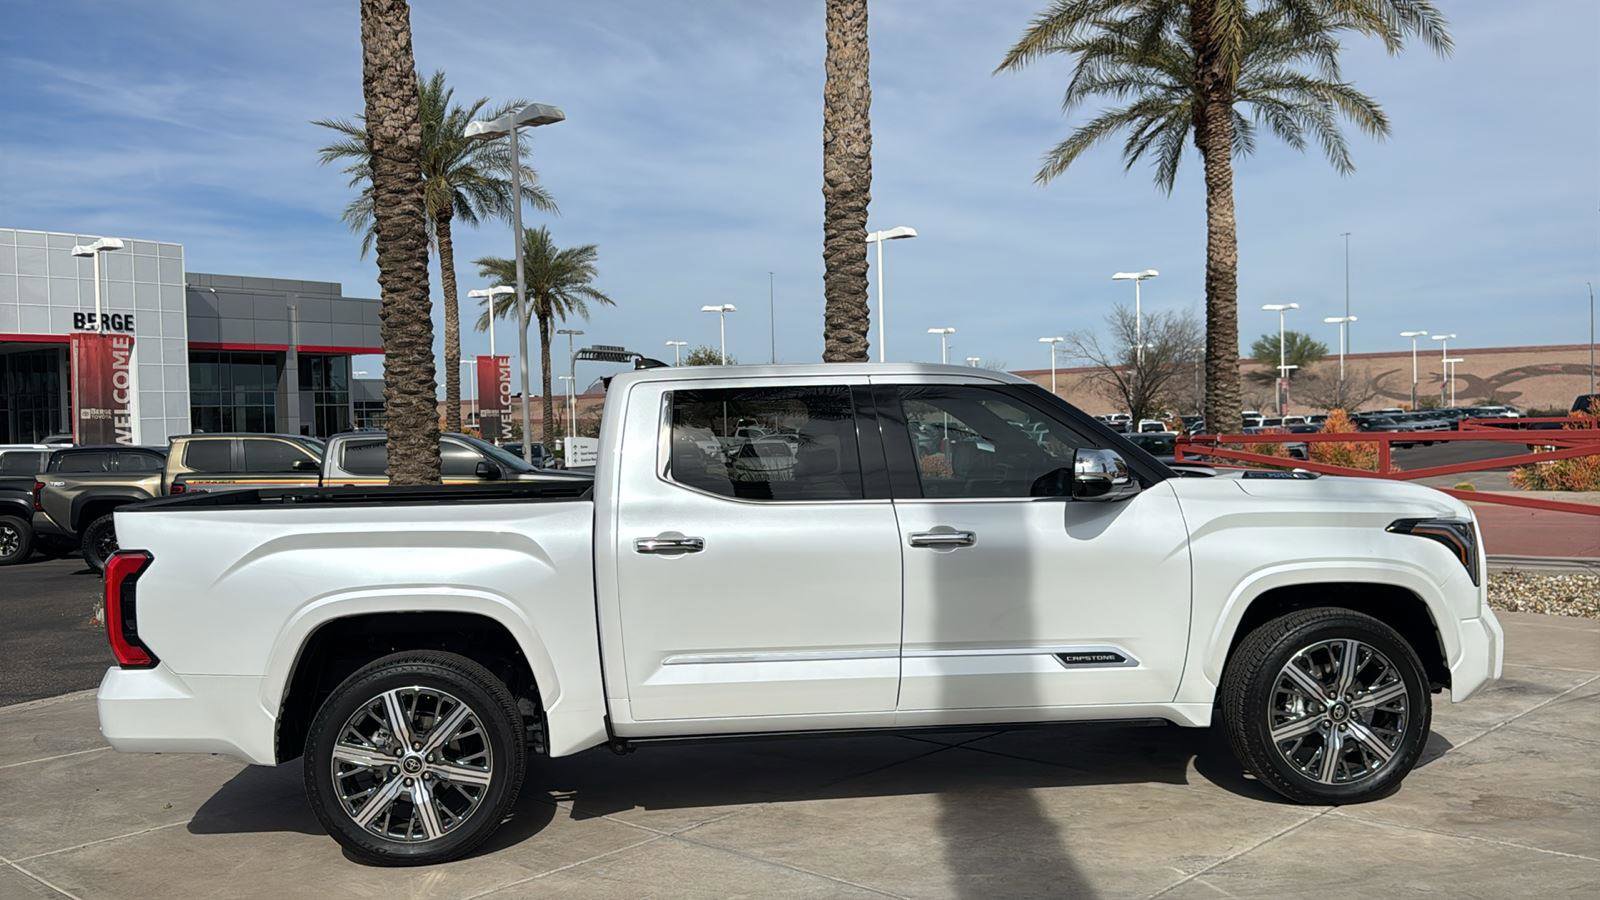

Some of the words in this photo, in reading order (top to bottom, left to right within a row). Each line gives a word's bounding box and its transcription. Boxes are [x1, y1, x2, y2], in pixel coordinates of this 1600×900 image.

[73, 312, 135, 331] BERGE
[113, 337, 133, 446] WELCOME
[499, 357, 513, 439] WELCOME
